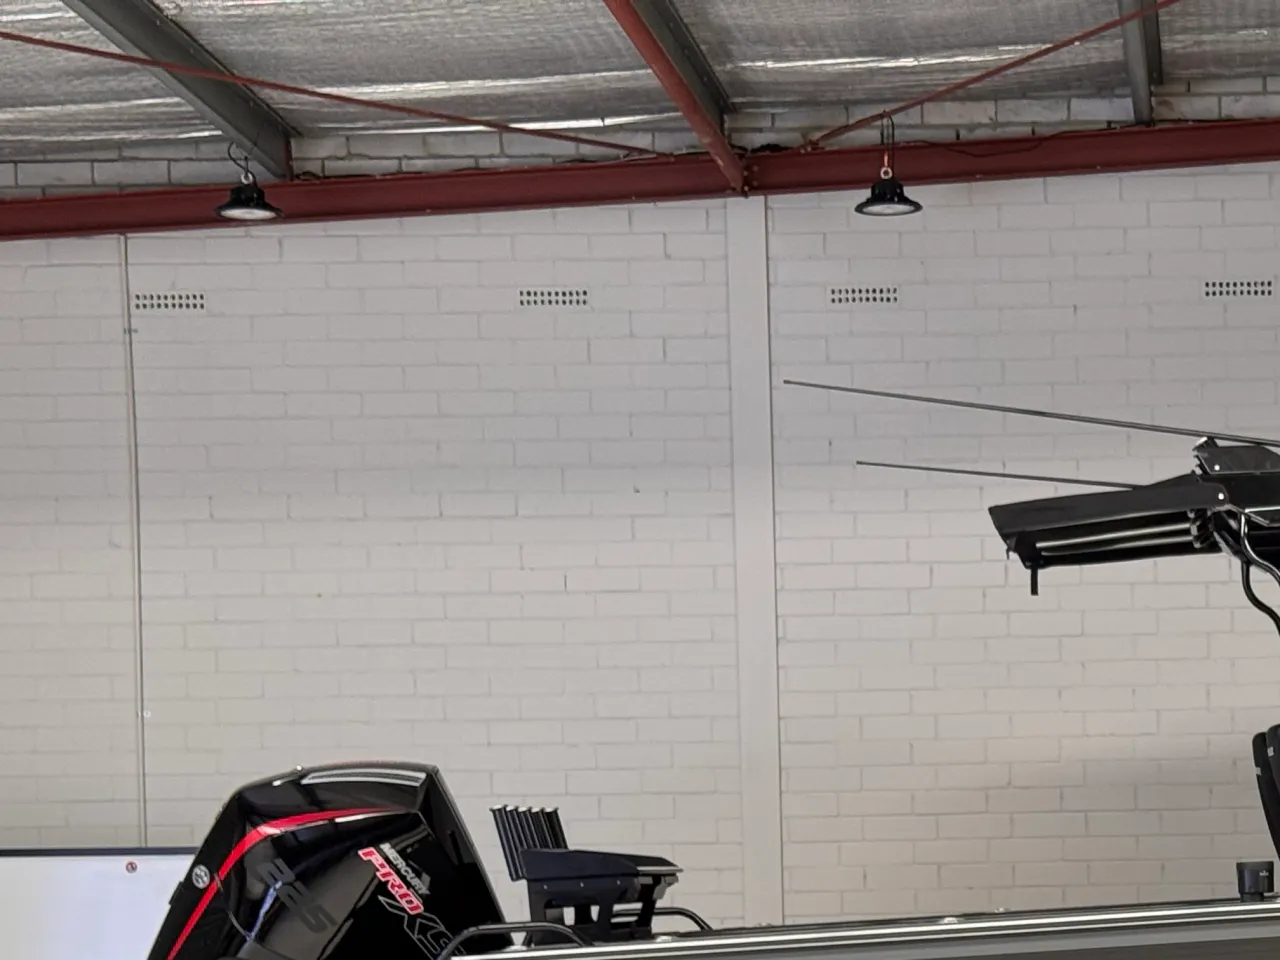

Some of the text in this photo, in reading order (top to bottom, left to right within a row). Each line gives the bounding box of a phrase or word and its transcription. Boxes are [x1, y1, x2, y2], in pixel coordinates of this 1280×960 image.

[256, 858, 340, 934] 225
[358, 847, 424, 915] PRO
[380, 842, 430, 894] MERCURY
